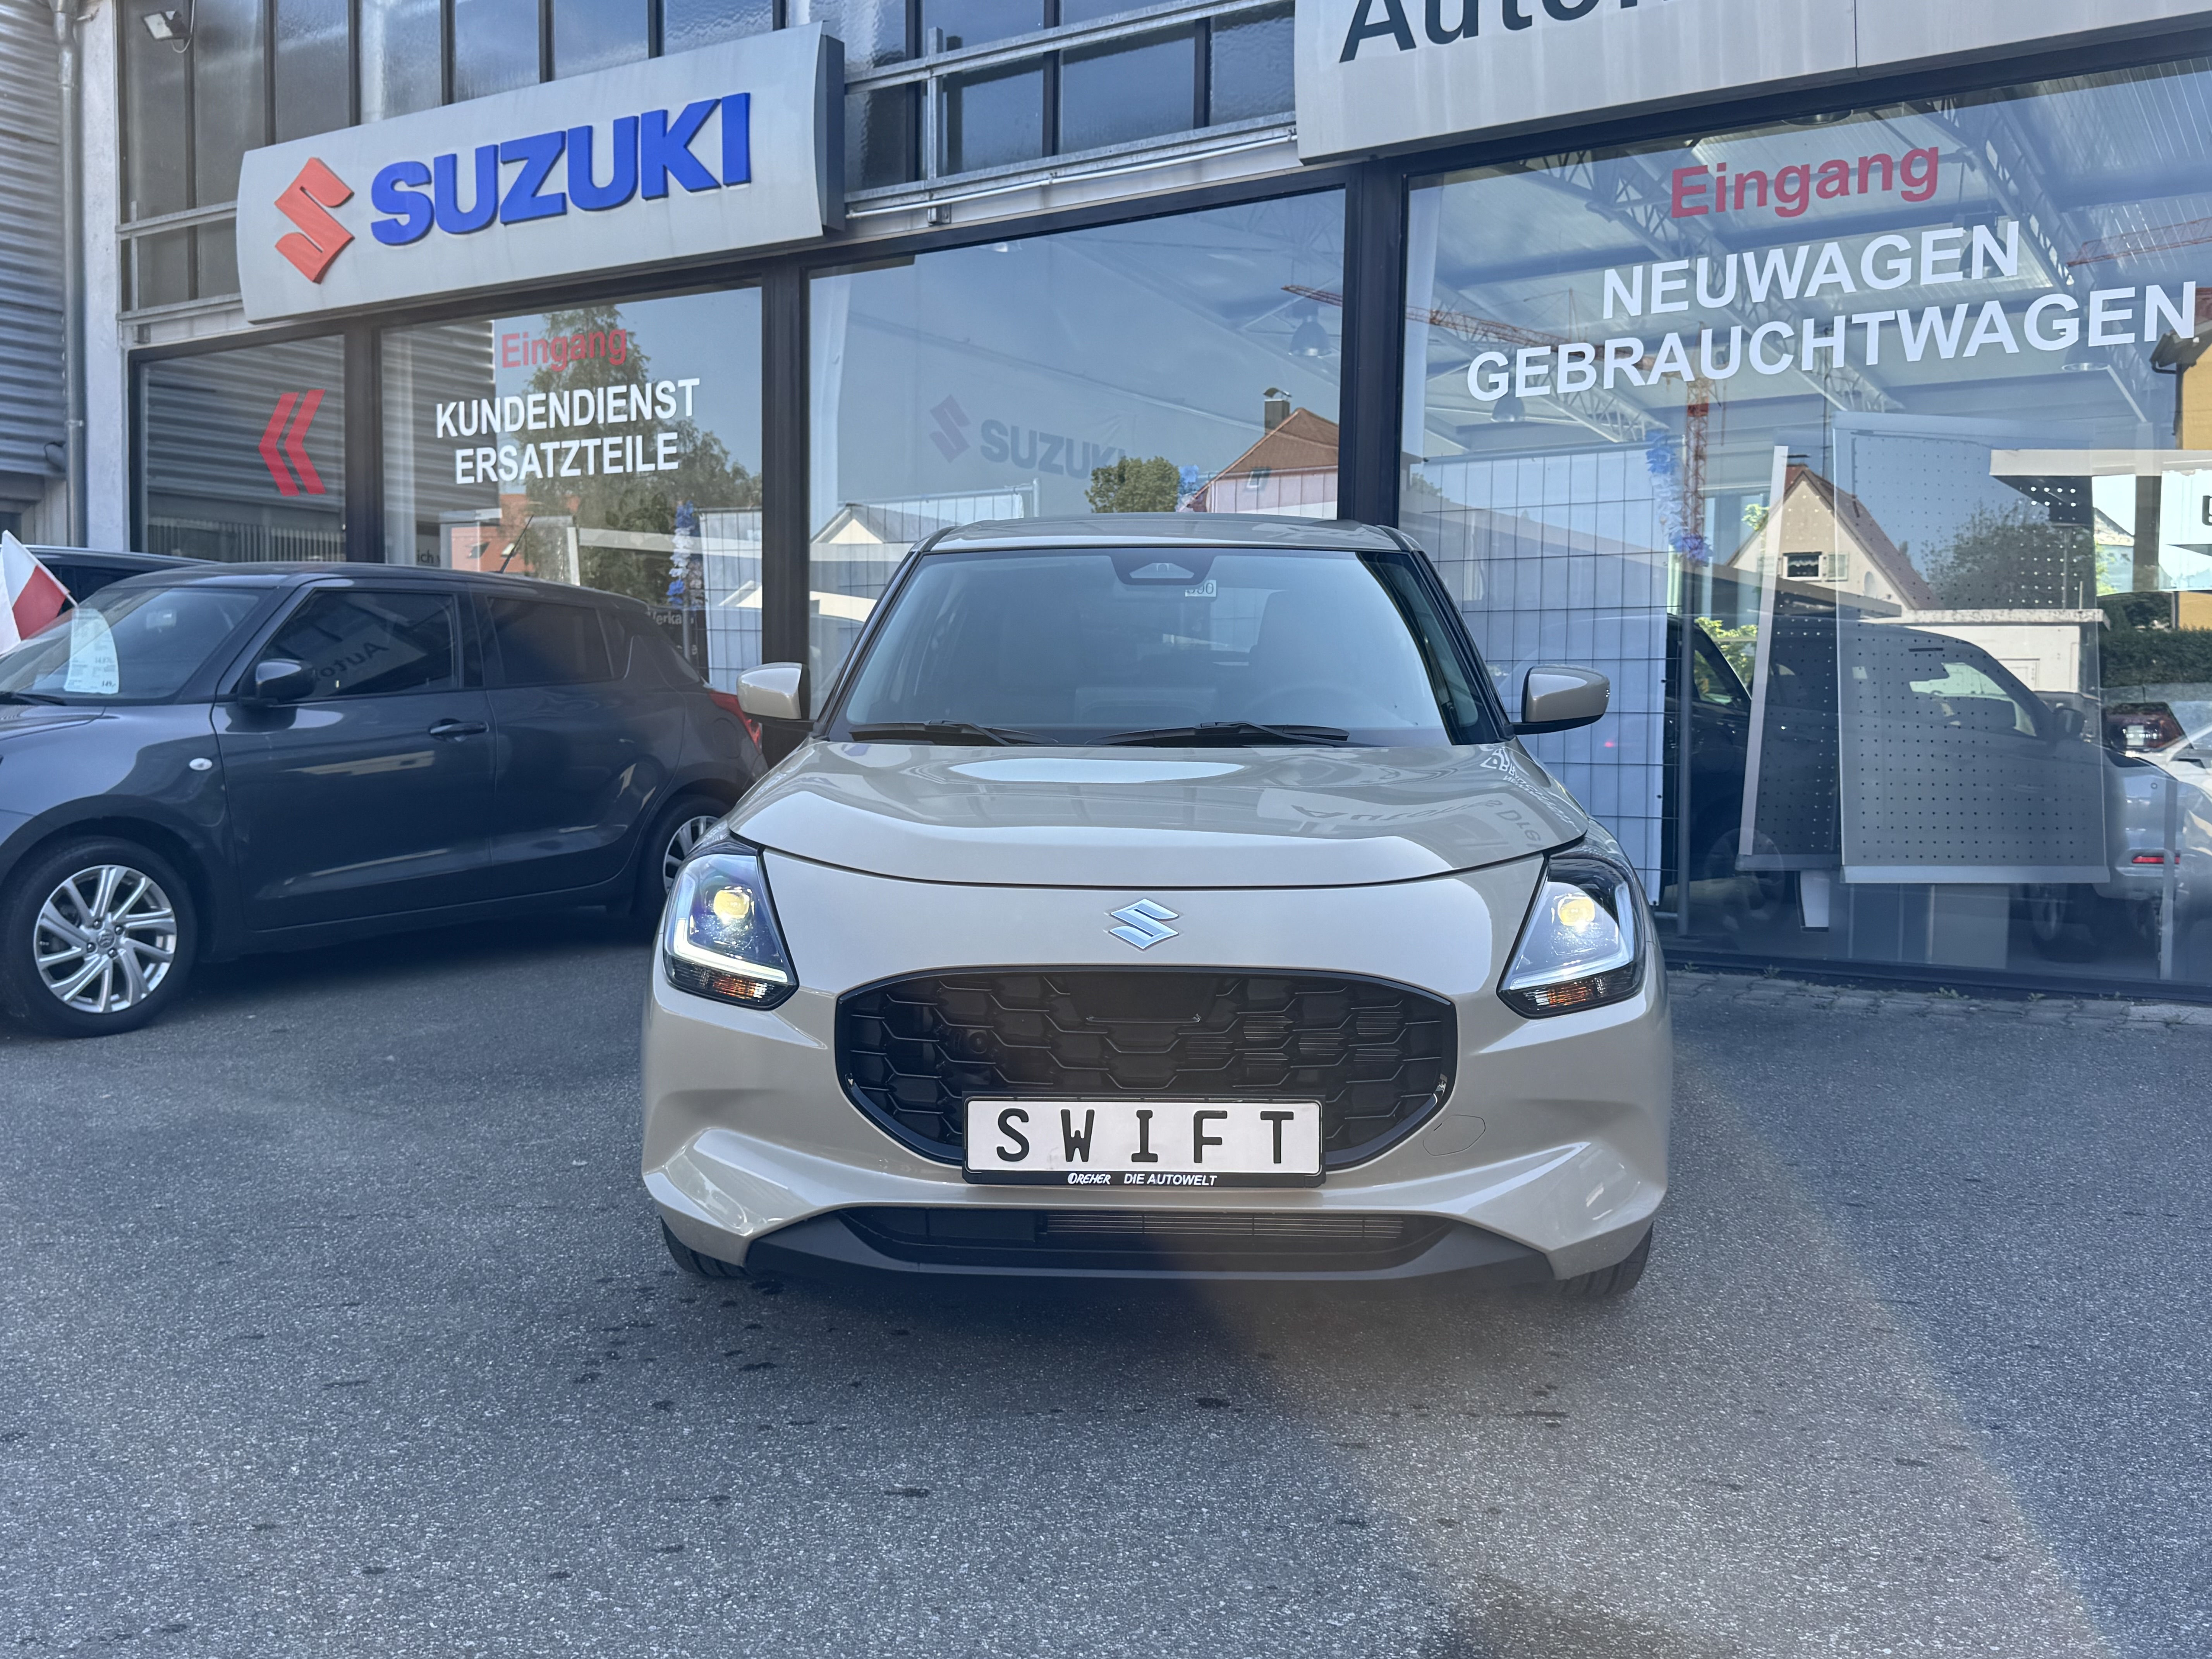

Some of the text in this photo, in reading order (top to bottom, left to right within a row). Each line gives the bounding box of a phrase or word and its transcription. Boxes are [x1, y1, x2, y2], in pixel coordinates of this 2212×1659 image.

[371, 93, 750, 246] SUZUKI
[1671, 146, 1939, 218] Eingang
[1602, 221, 2019, 319] NEUWAGEN
[502, 329, 626, 371] Eingang
[1467, 280, 2196, 402] GEBRAUCHTWAGEN
[436, 378, 700, 438] KUNDENDIENST
[456, 432, 678, 484] ERSATZTEILE
[980, 419, 1125, 479] SUZUK
[996, 1108, 1294, 1164] SWIFT
[1124, 1173, 1145, 1184] DIE
[1147, 1174, 1217, 1185] AUTOWELT
